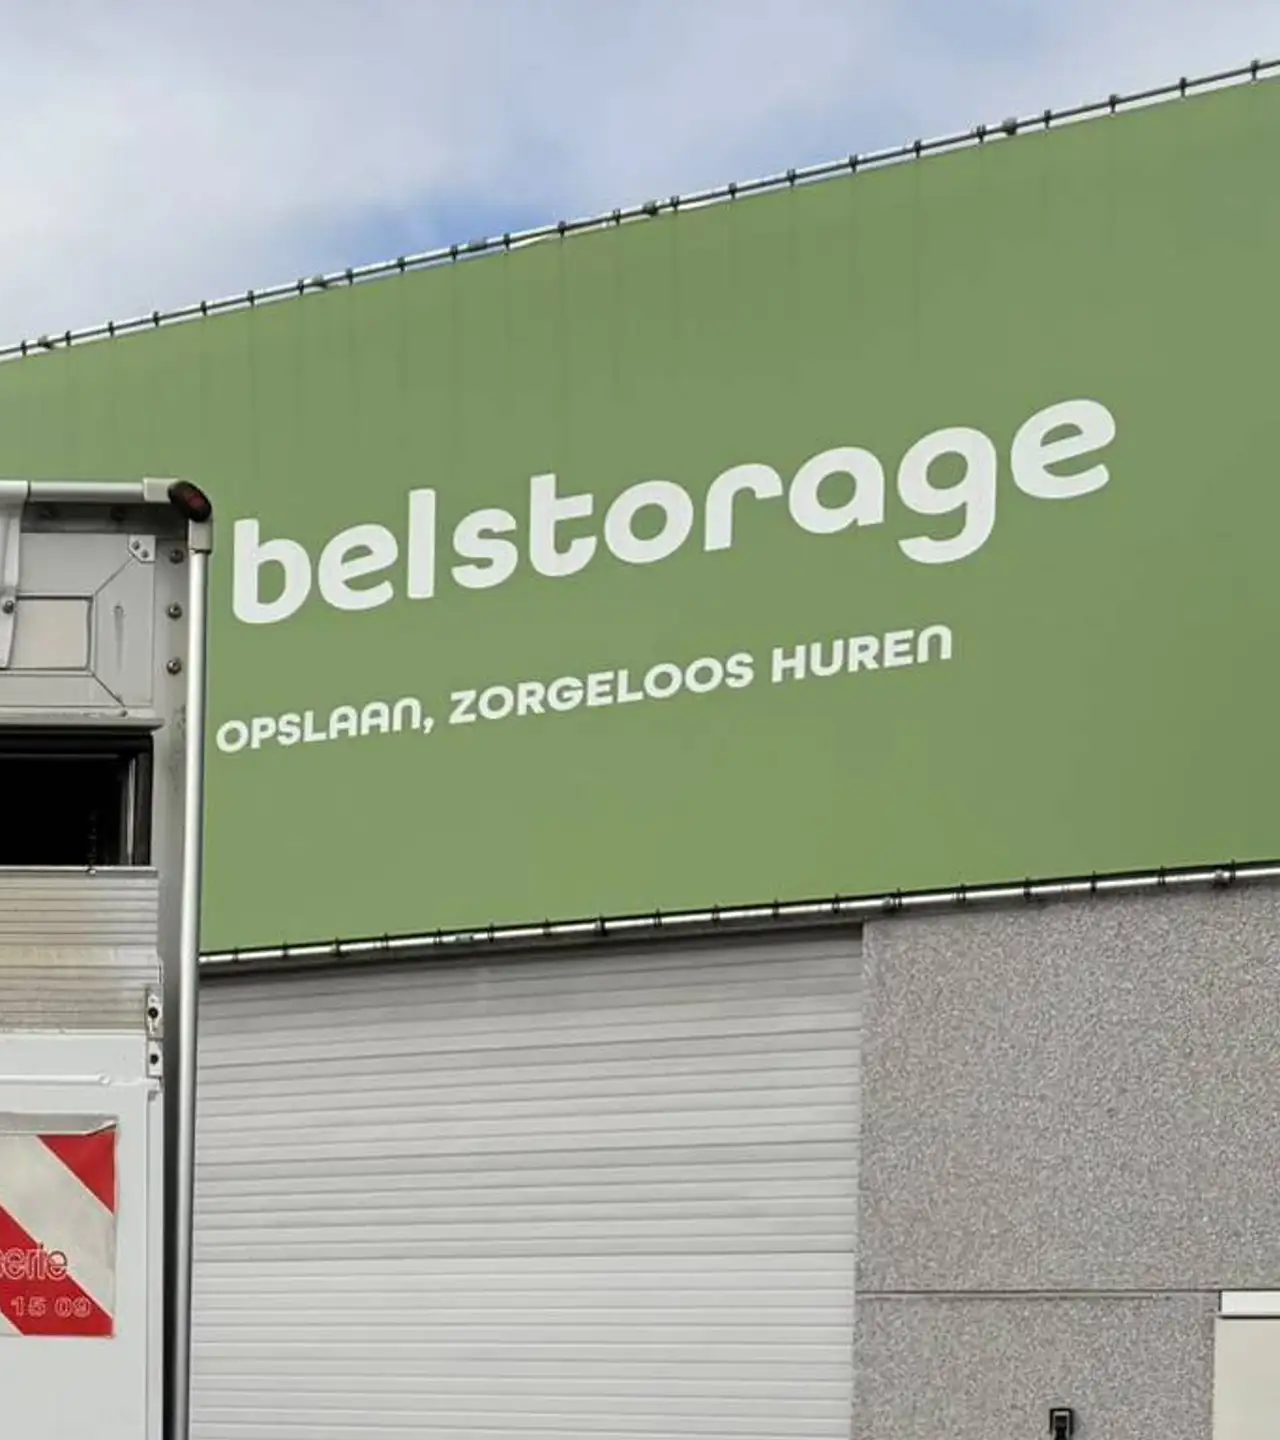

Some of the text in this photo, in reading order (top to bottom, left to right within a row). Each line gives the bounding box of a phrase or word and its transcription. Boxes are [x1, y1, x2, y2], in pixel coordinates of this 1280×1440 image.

[232, 398, 1117, 624] belstorage
[216, 623, 953, 753] OPSLAAN, ZORGELOOS HUREN
[11, 1296, 47, 1317] 15
[55, 1296, 93, 1318] 09
